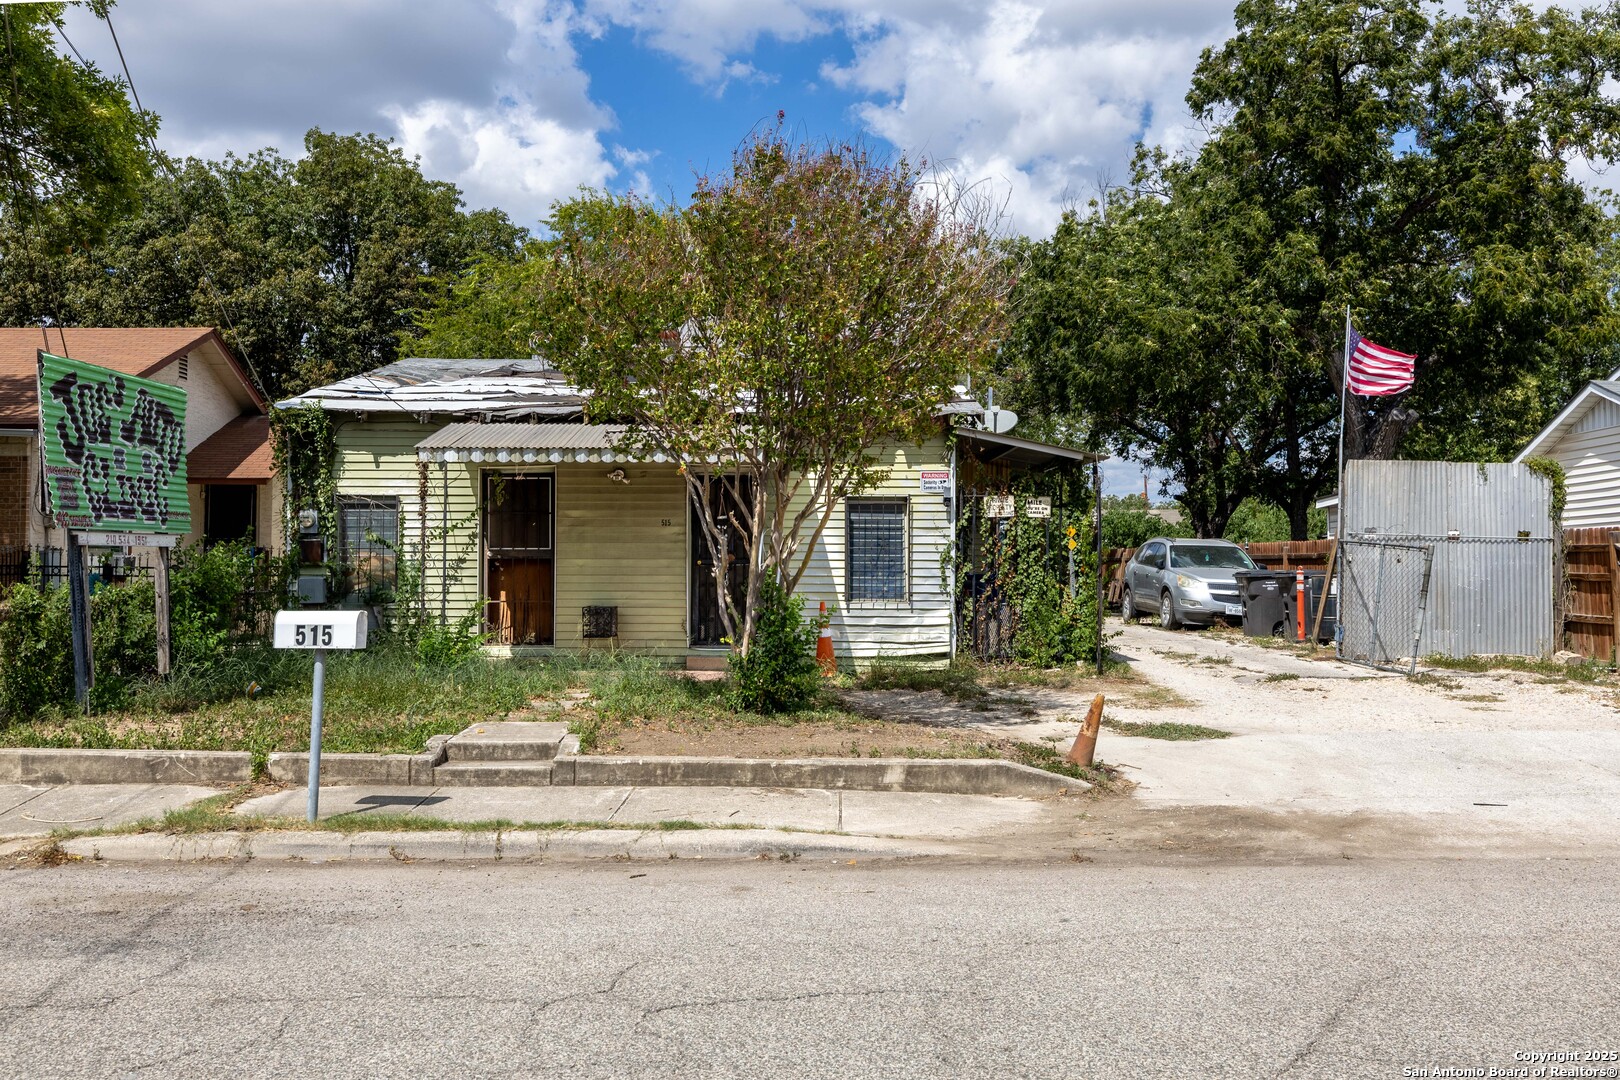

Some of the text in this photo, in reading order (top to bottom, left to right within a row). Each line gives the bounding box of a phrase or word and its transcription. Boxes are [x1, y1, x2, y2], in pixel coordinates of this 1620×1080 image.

[119, 387, 184, 478] AUTO
[661, 519, 672, 527] 515
[106, 534, 117, 545] 210
[118, 534, 130, 545] 534
[295, 624, 332, 646] 515
